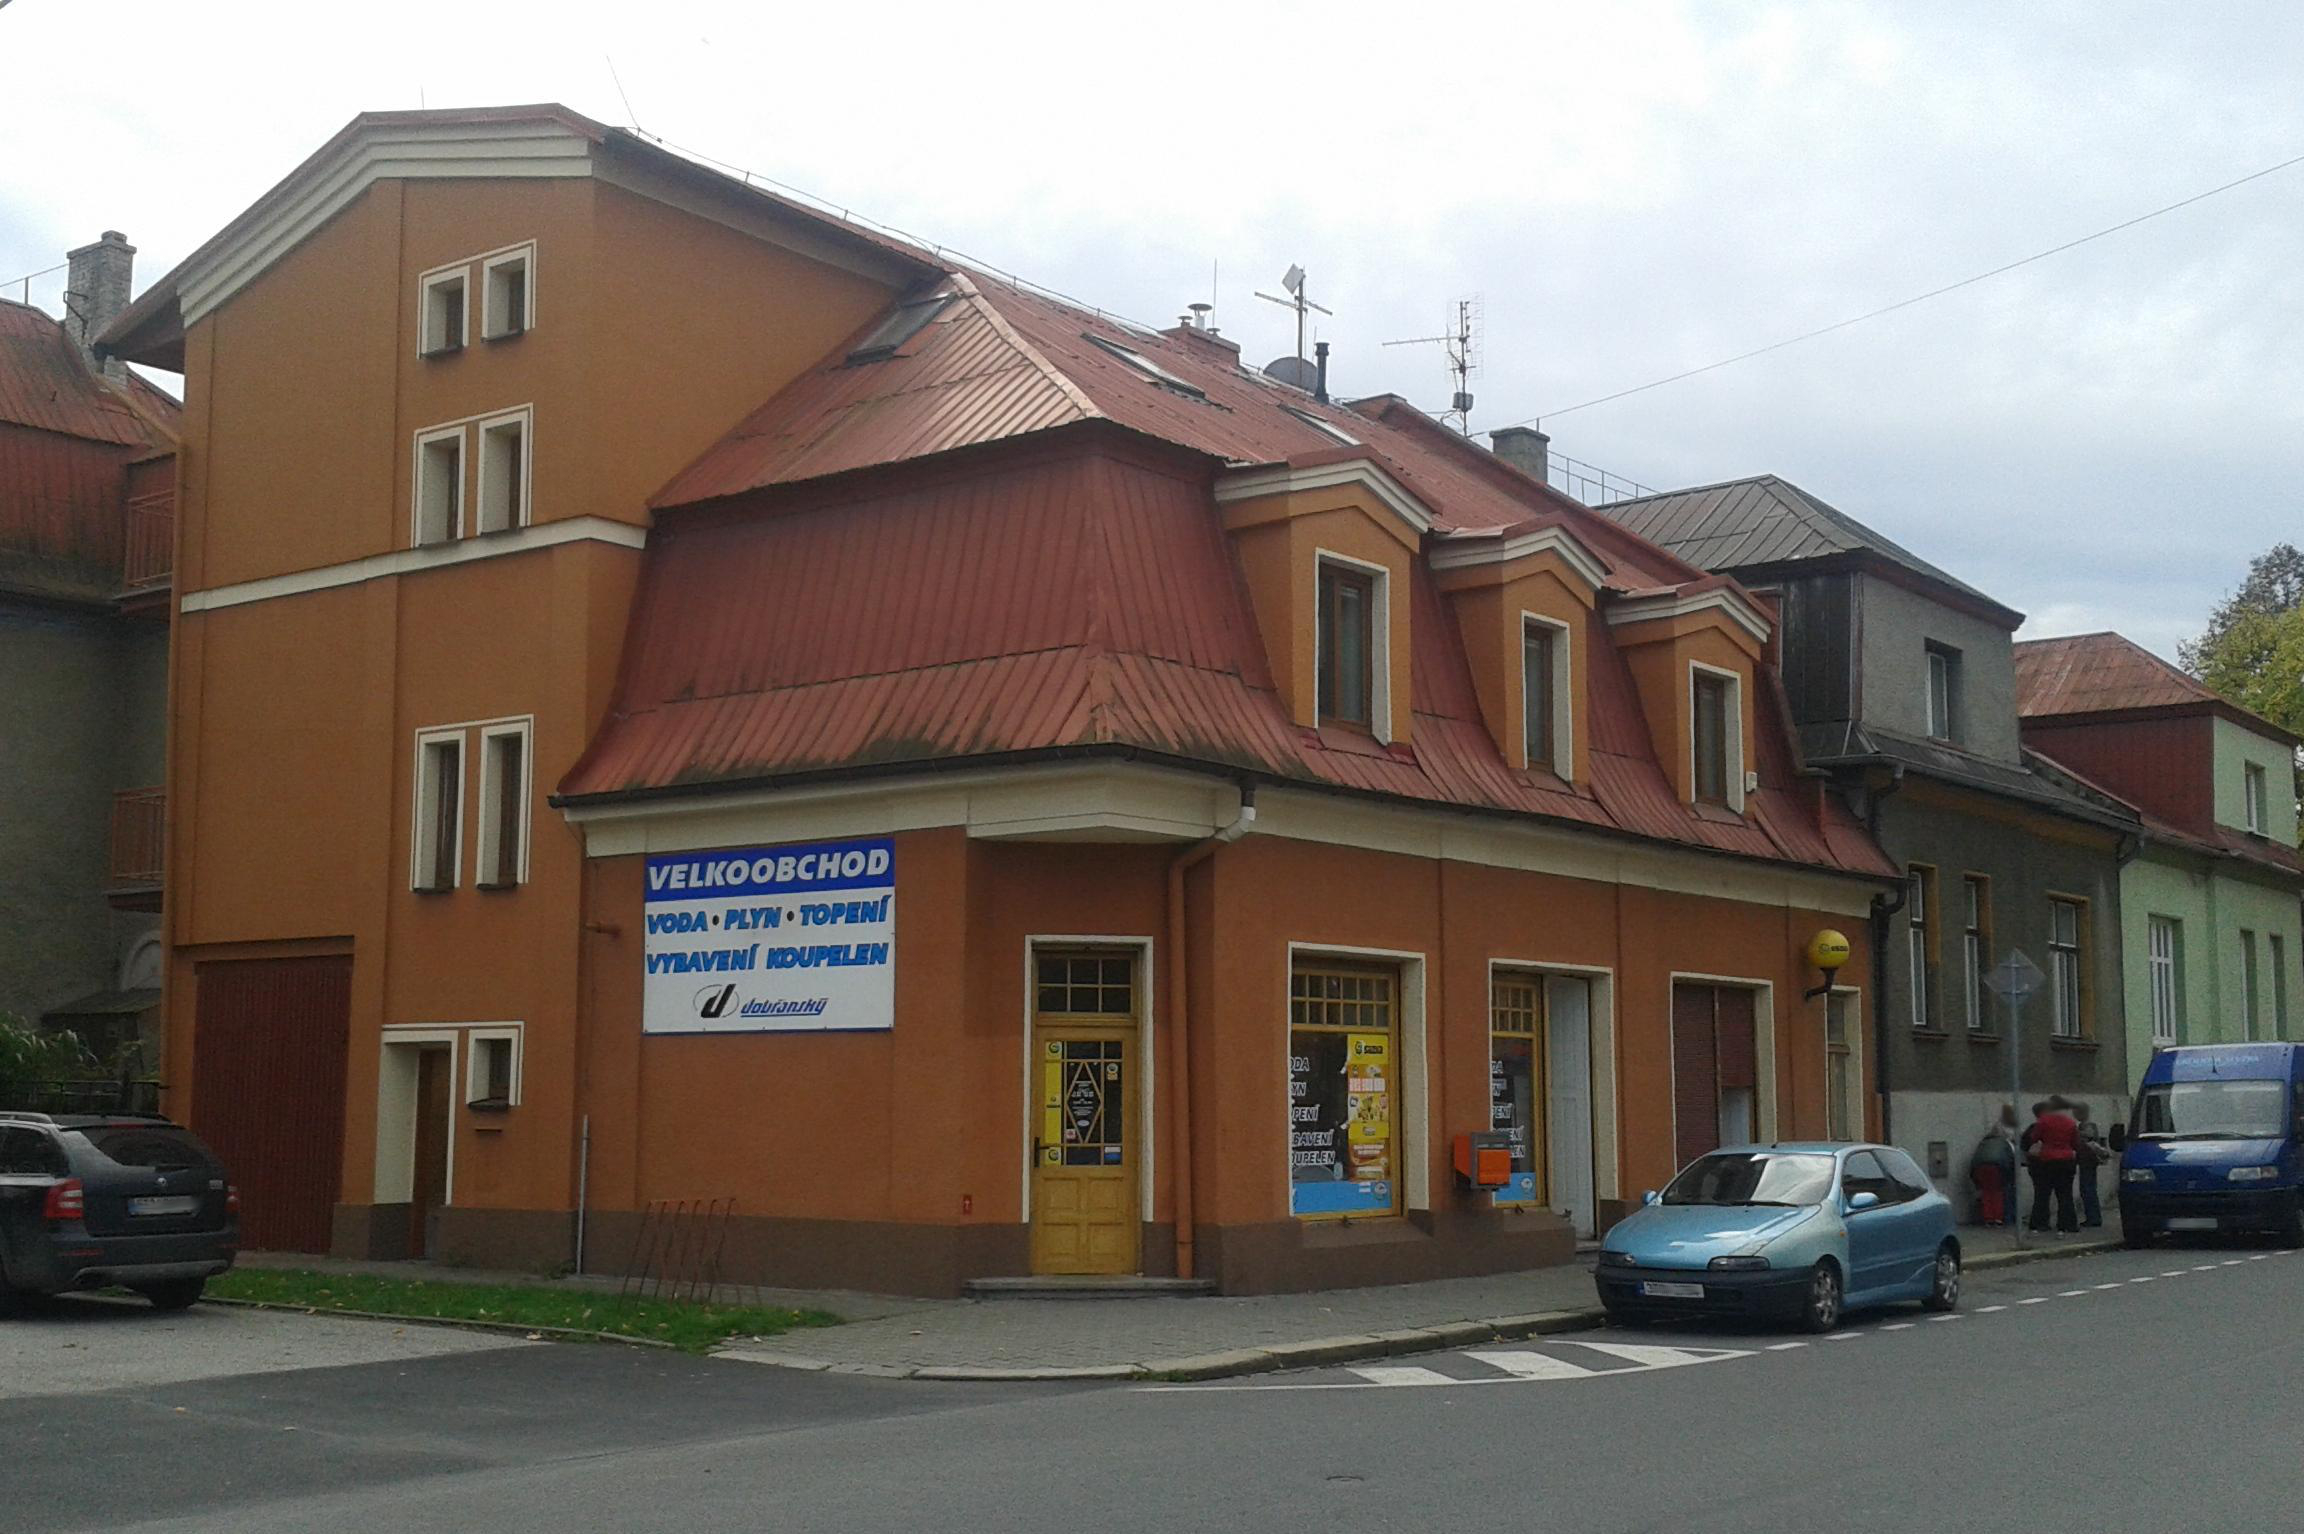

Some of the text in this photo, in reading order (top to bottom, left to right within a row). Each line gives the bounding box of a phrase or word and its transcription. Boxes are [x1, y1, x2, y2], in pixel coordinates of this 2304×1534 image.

[649, 848, 890, 890] VELKOOBCHOD
[647, 895, 892, 934] VODA PLYN TOPENÍ
[646, 943, 889, 974] VYBAVENÍ KOUPELEN
[1291, 1057, 1309, 1071] DA
[1293, 1104, 1320, 1121] PENÍ
[1292, 1129, 1334, 1146] BAVENÍ
